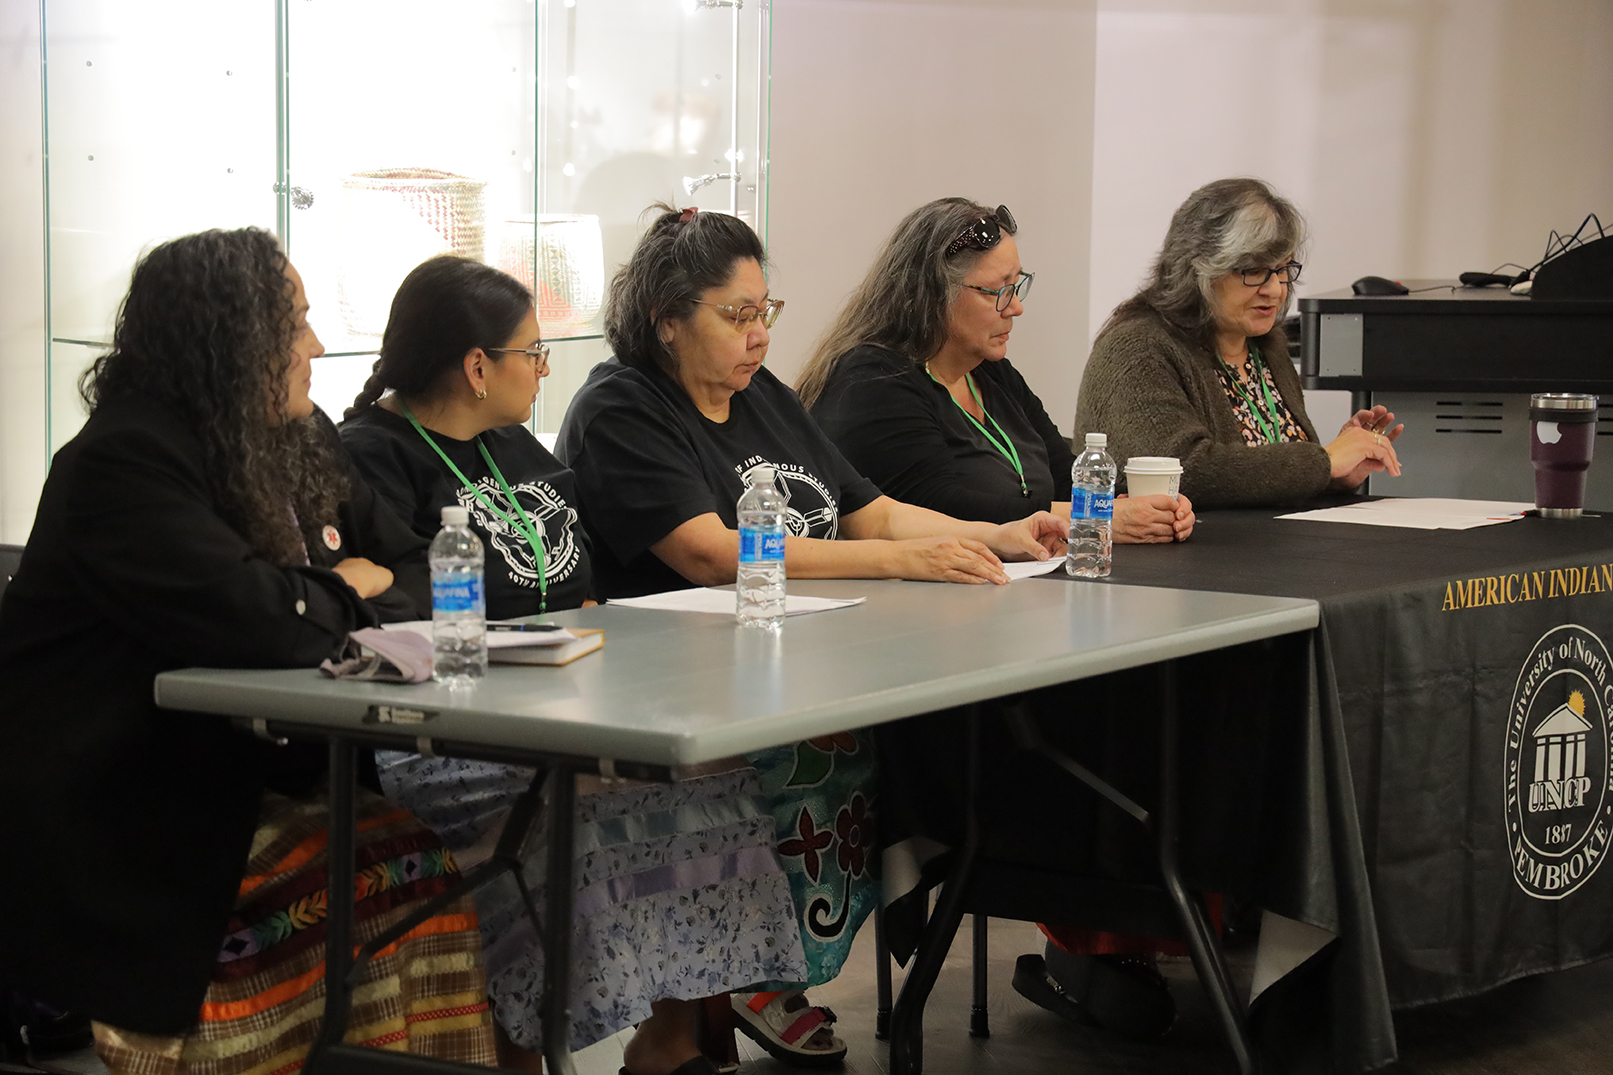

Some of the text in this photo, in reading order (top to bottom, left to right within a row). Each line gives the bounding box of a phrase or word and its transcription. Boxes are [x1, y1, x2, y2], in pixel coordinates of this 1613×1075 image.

[1441, 563, 1613, 611] AMERICAN INDIAN
[1558, 636, 1574, 660] of
[1573, 637, 1606, 687] North
[1509, 646, 1555, 750] University
[1508, 758, 1517, 813] The
[1527, 776, 1592, 813] UNCP
[1513, 819, 1609, 891] PEMBROKE
